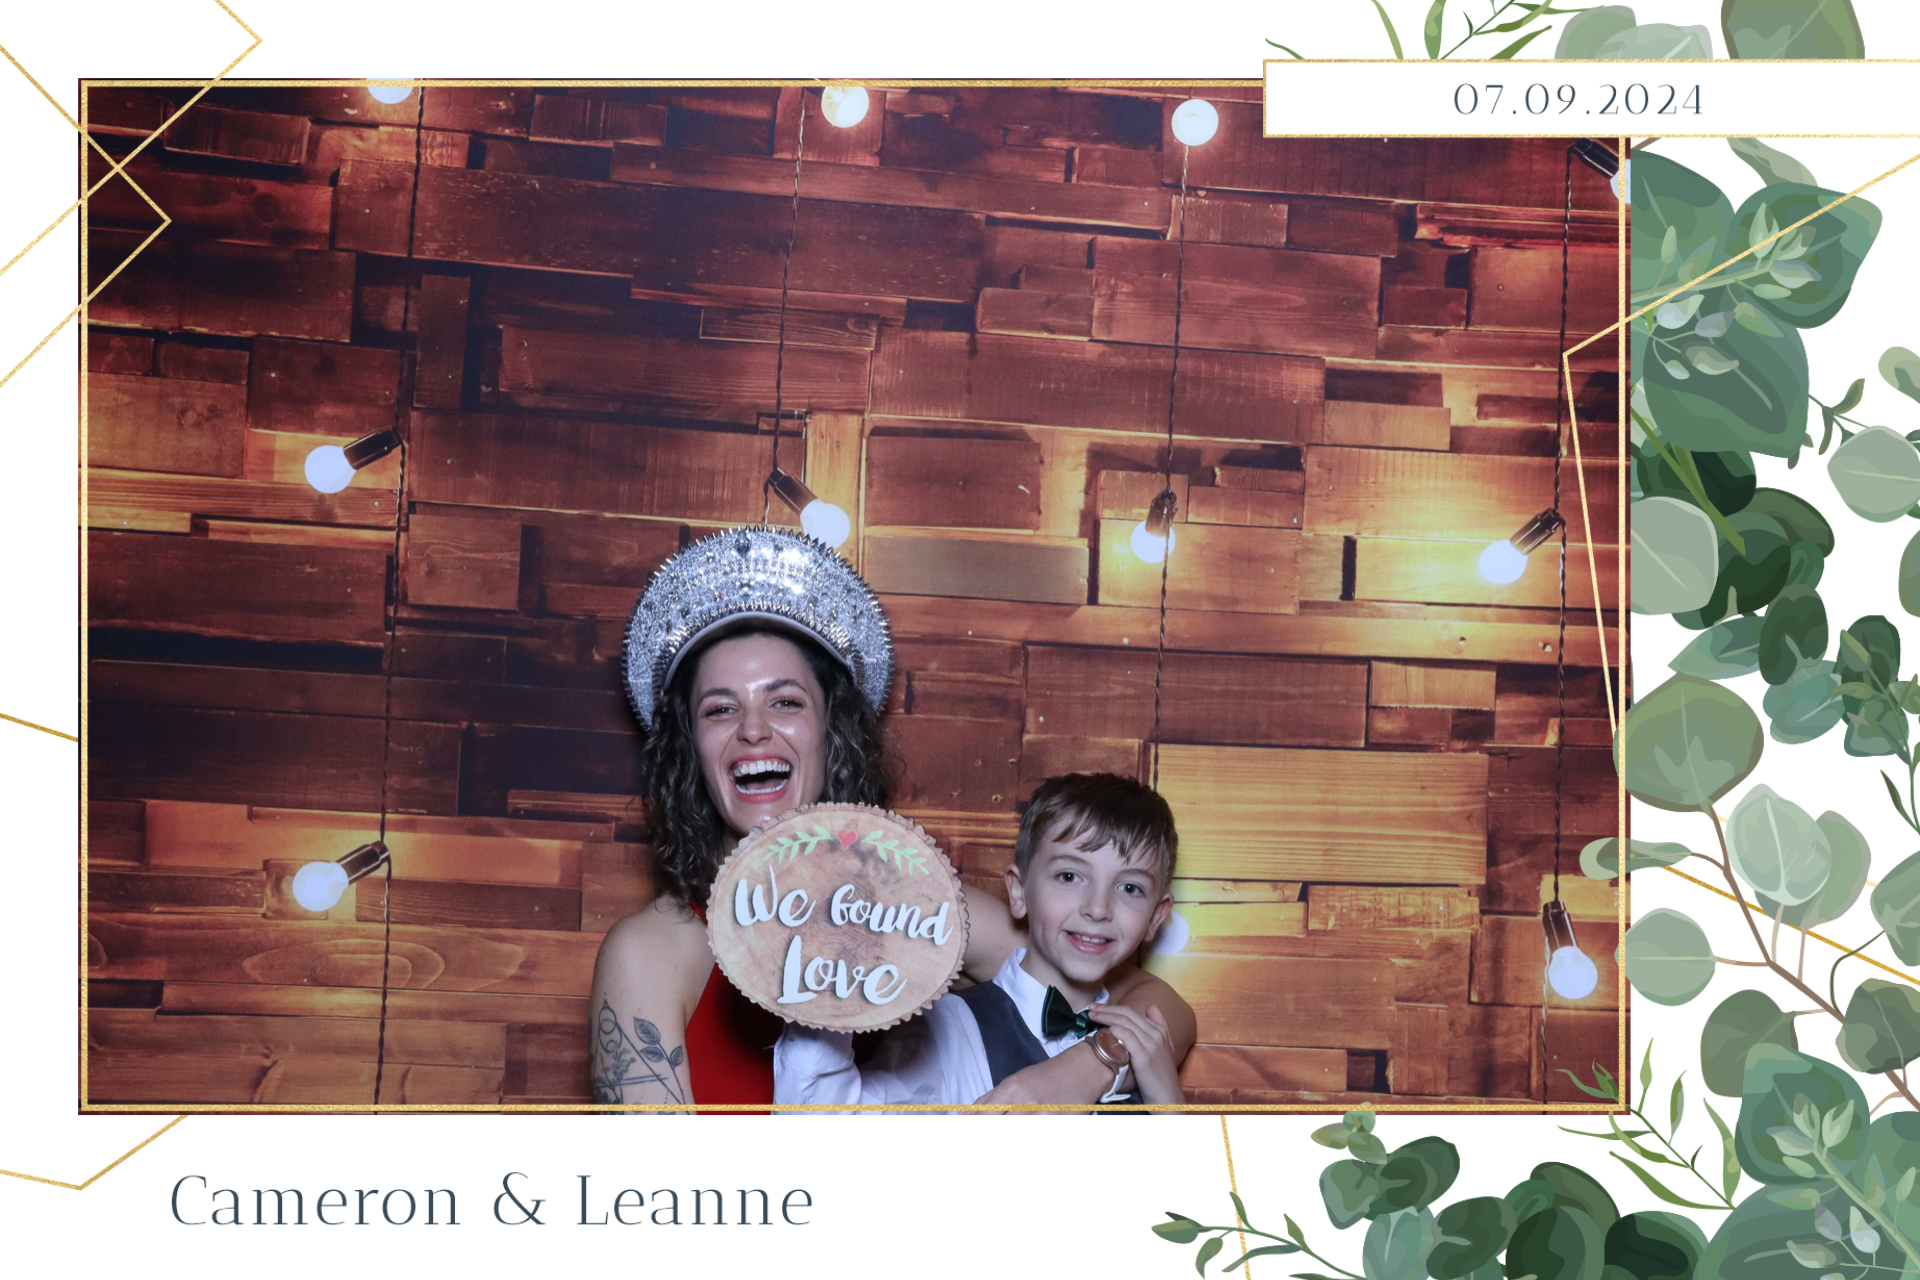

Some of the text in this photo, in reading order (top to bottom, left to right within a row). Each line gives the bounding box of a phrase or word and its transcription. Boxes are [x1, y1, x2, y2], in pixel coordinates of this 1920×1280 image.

[735, 864, 953, 945] We found
[777, 935, 907, 1004] Love
